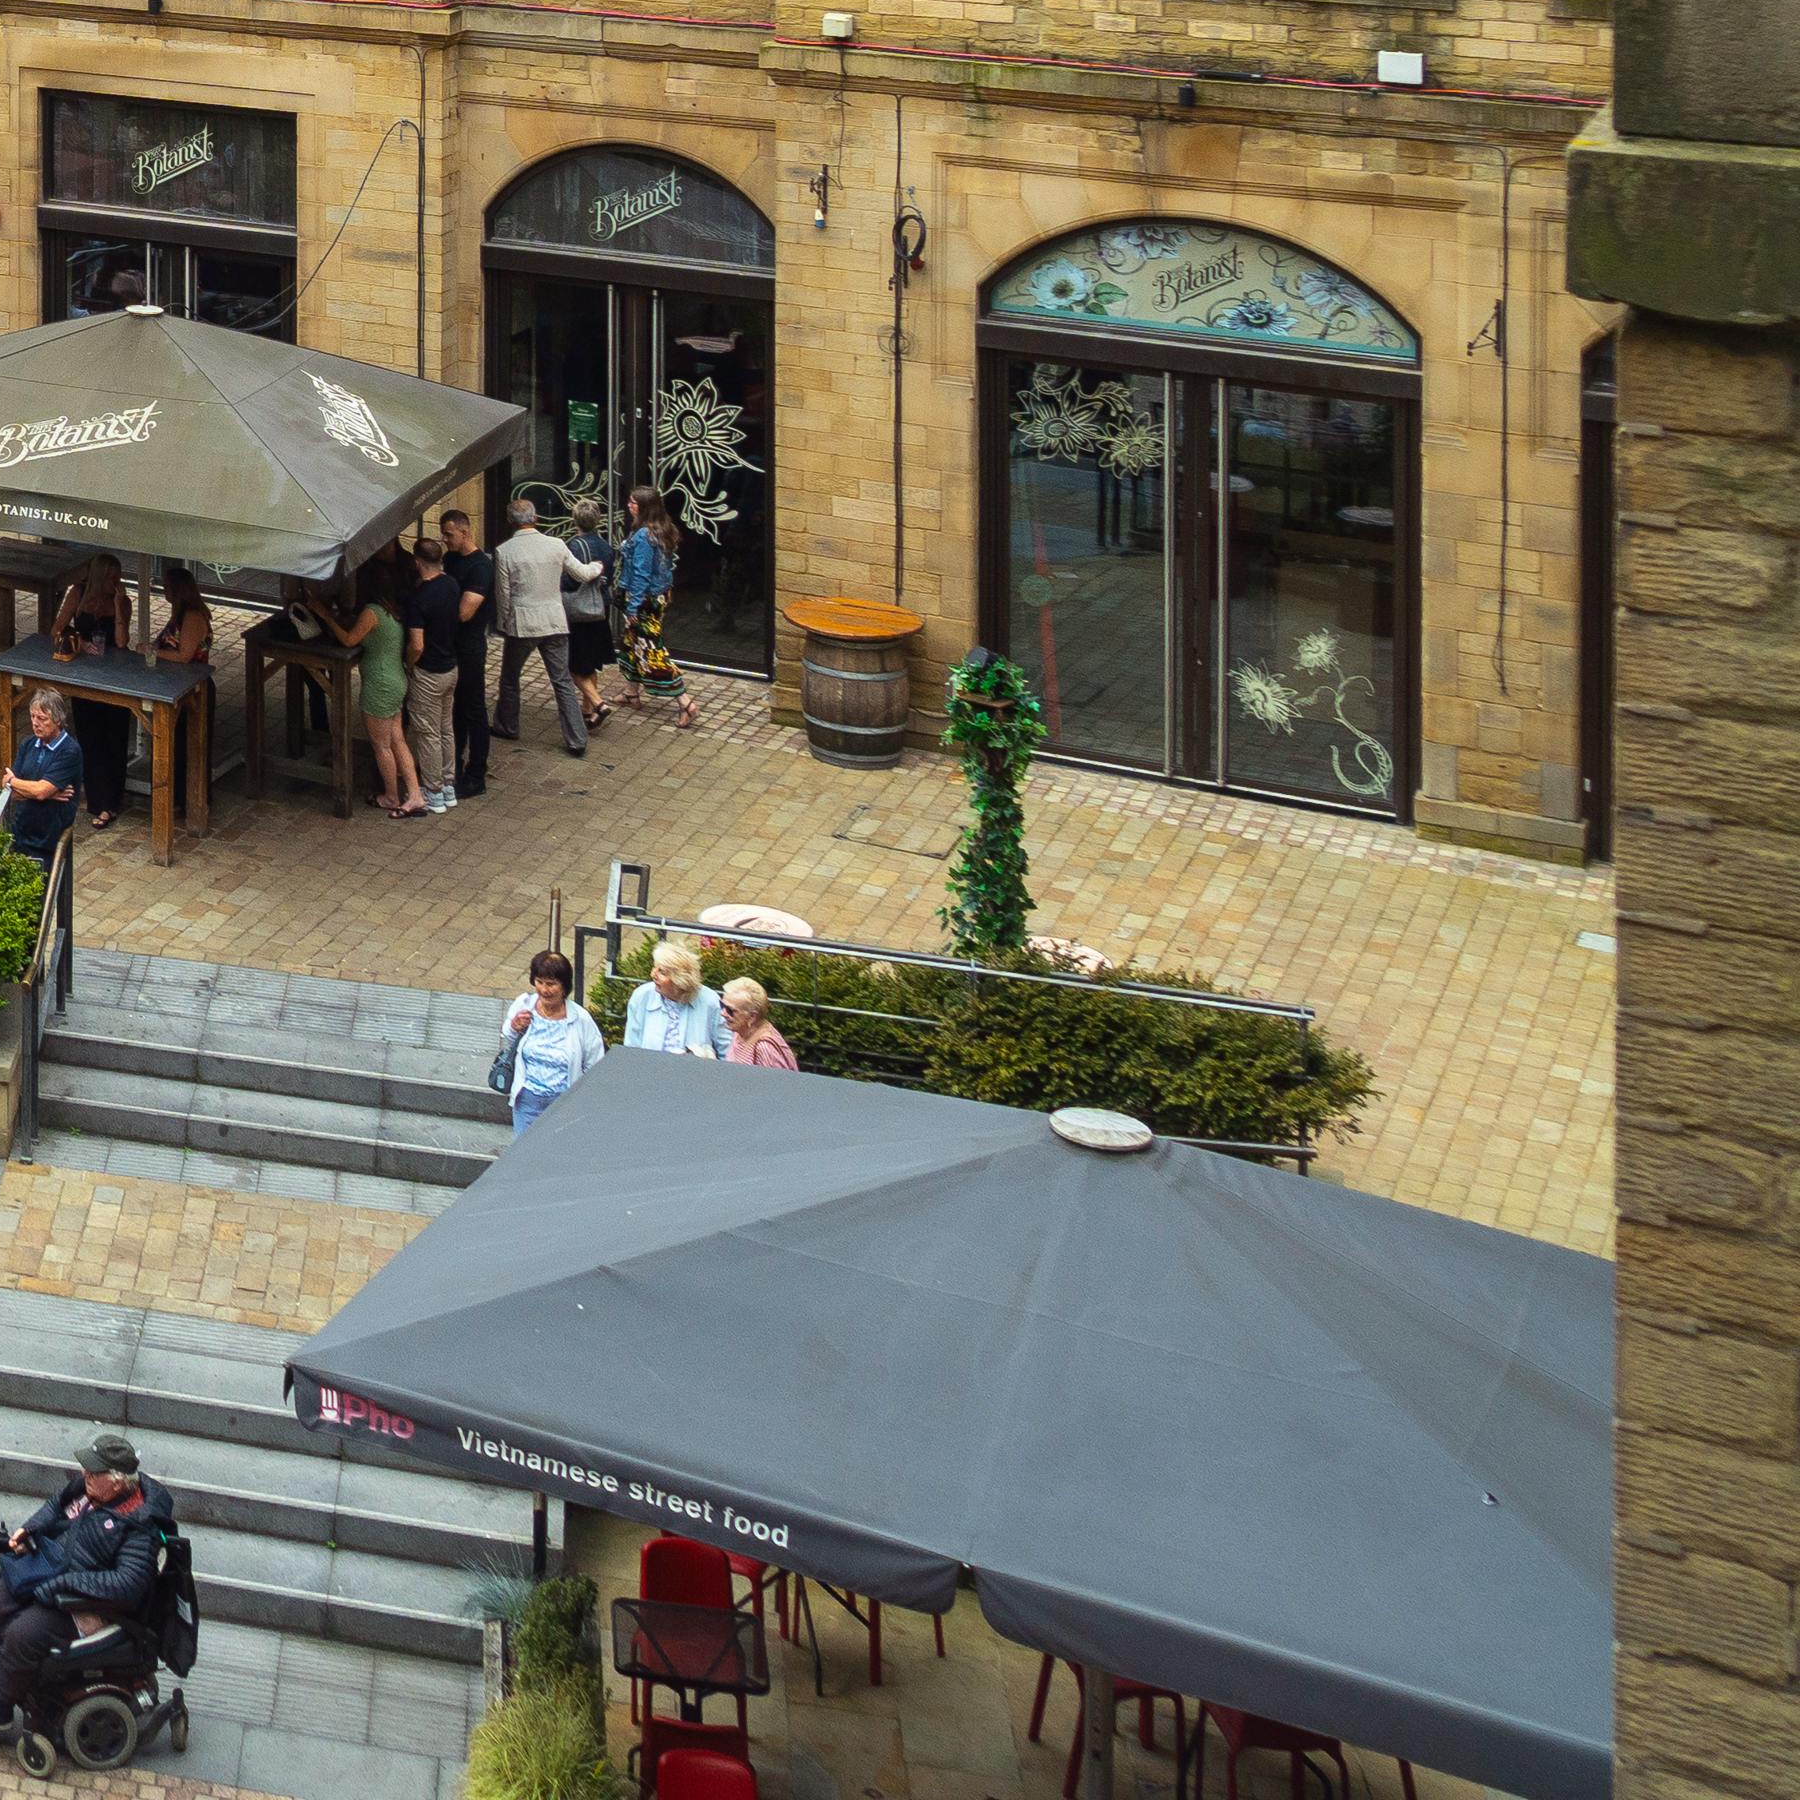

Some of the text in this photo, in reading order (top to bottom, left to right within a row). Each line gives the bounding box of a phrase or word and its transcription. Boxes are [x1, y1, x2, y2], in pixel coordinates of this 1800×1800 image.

[131, 121, 214, 195] Botanist
[588, 165, 683, 242] Botanist
[1151, 241, 1245, 313] Botanist
[342, 1391, 416, 1440] Pho
[456, 1425, 789, 1550] Vietnamese street food
